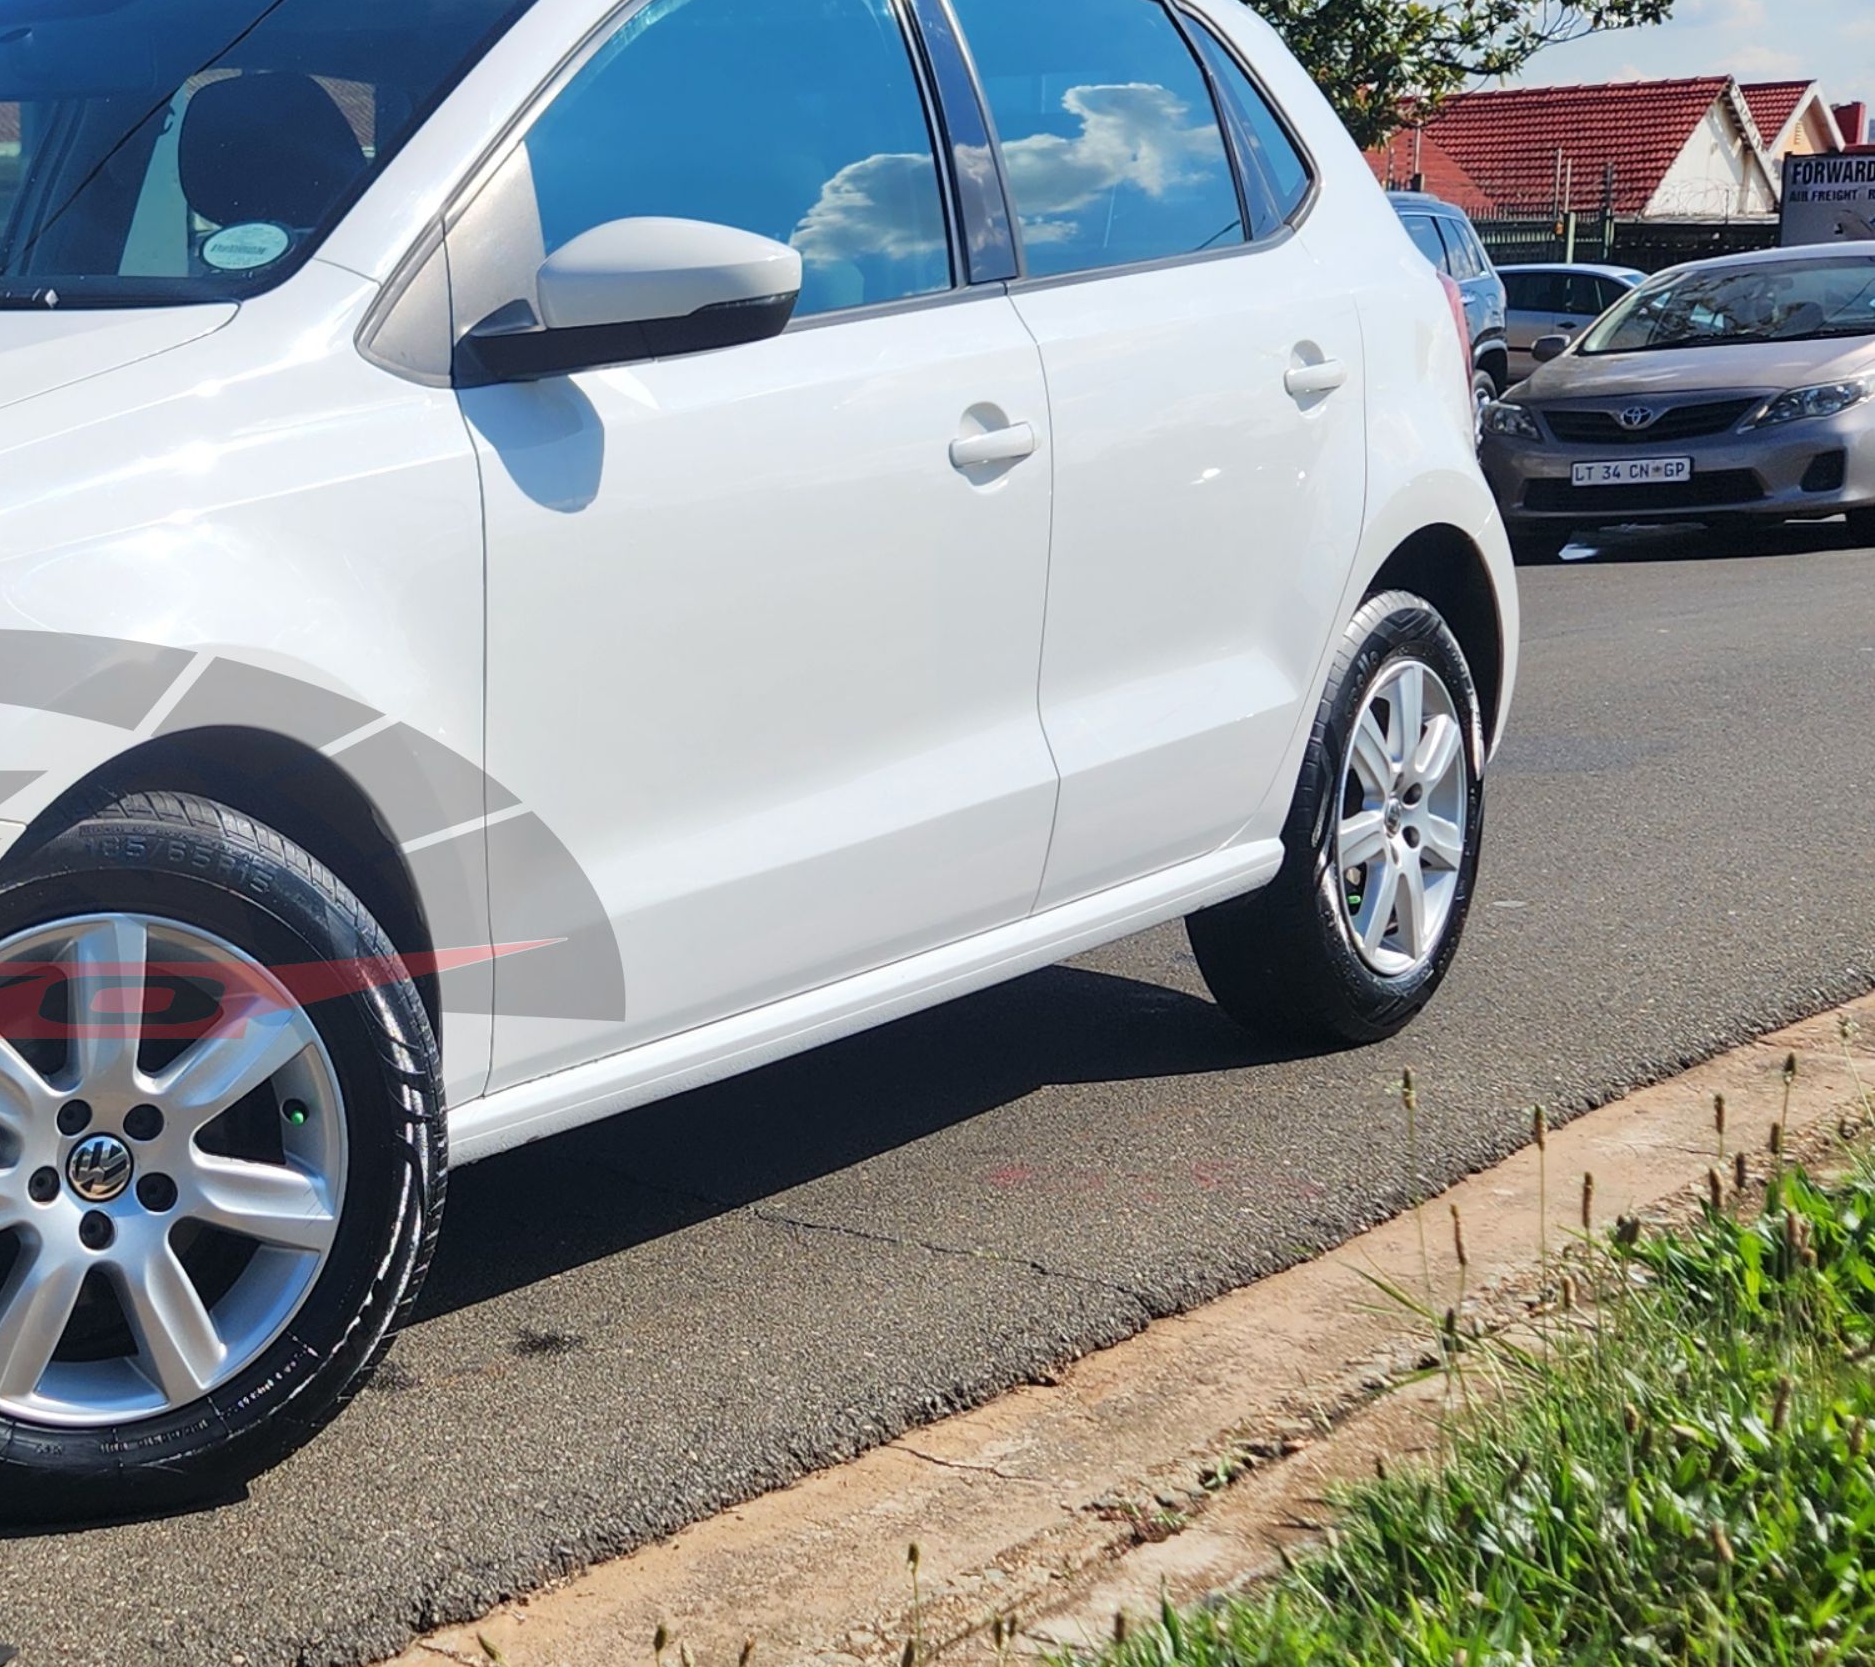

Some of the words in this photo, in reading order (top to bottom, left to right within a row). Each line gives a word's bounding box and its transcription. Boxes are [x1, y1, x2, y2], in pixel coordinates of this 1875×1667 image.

[1791, 160, 1875, 185] FORWARD
[1811, 189, 1859, 202] FREIGHT
[1574, 465, 1595, 482] LT
[1601, 464, 1622, 480] 34
[1629, 463, 1650, 479] CN
[1663, 461, 1686, 478] GP
